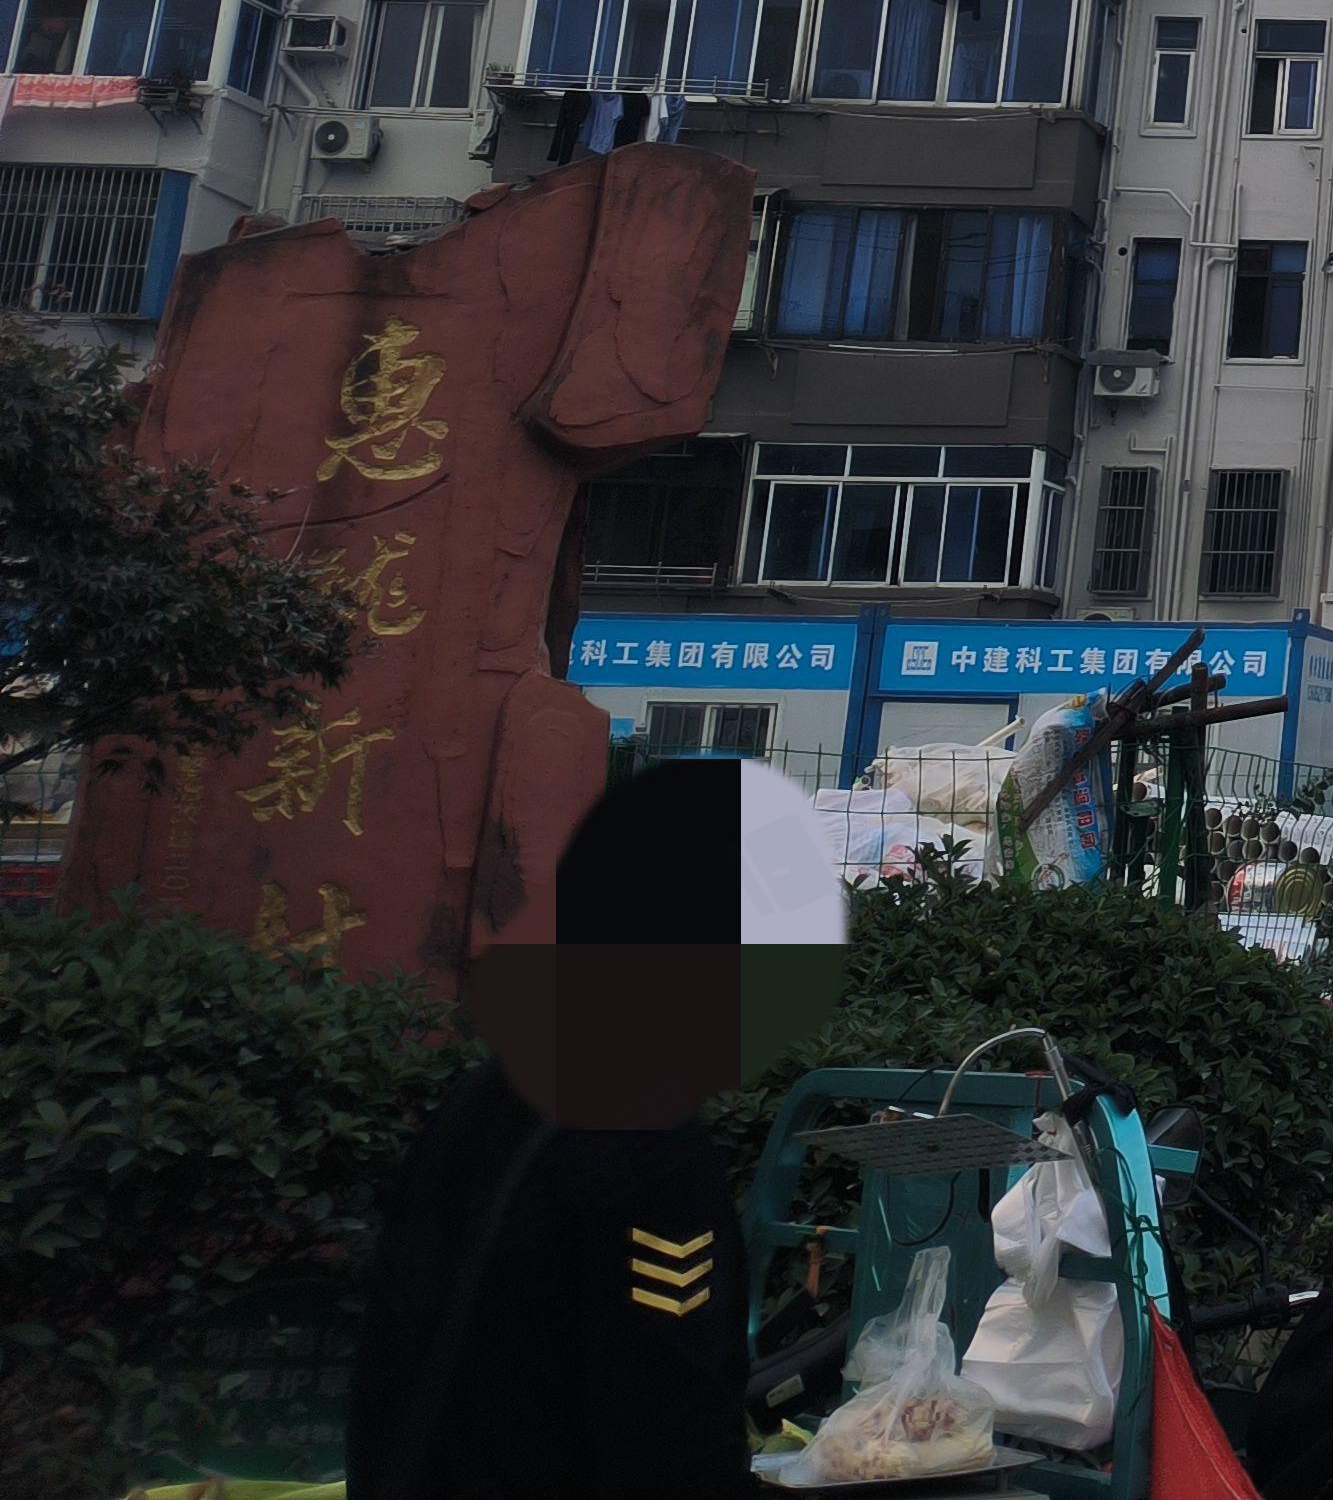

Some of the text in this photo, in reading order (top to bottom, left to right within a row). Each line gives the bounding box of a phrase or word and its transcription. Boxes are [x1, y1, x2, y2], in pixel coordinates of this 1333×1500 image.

[570, 638, 837, 672] 科工集团有限公司
